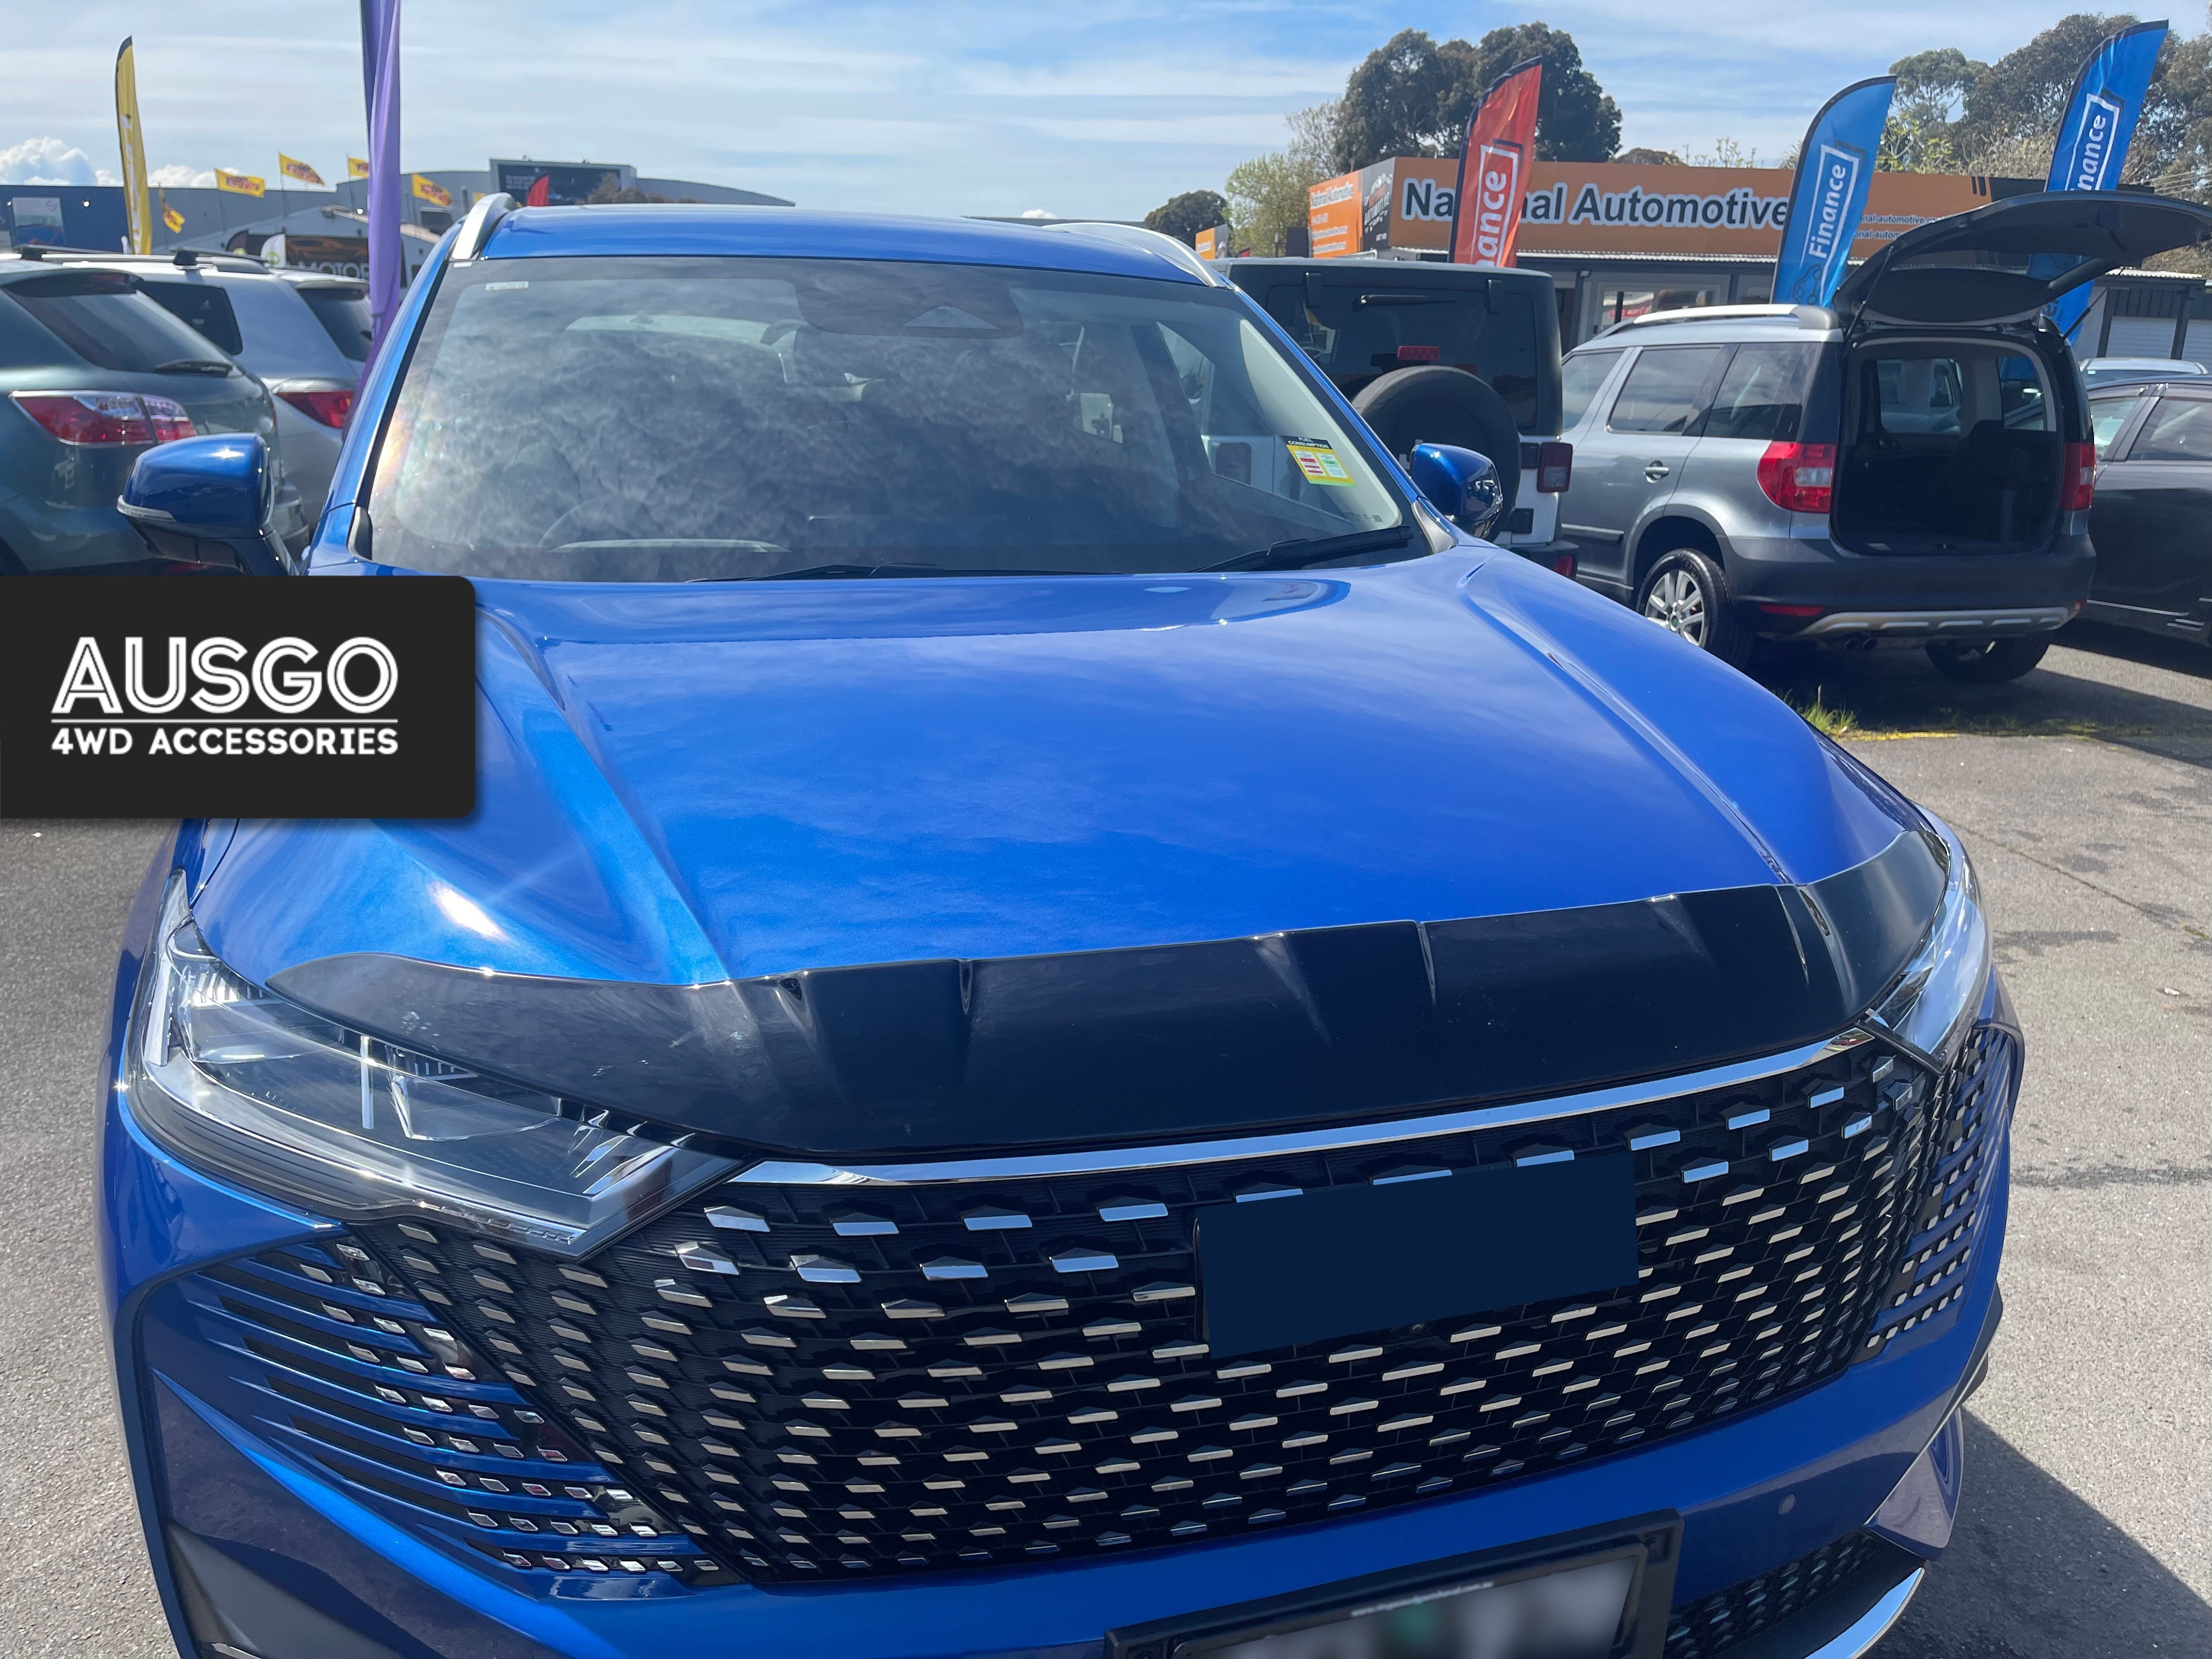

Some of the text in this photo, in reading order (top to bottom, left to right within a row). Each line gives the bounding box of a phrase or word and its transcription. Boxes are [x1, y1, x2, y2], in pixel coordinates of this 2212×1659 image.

[2071, 115, 2106, 191] nance
[1404, 182, 1564, 221] Naal
[1572, 187, 1787, 226] Automotive
[1476, 171, 1506, 267] ance
[1809, 165, 1846, 259] Finance
[1288, 441, 1329, 449] CONSUMPTION
